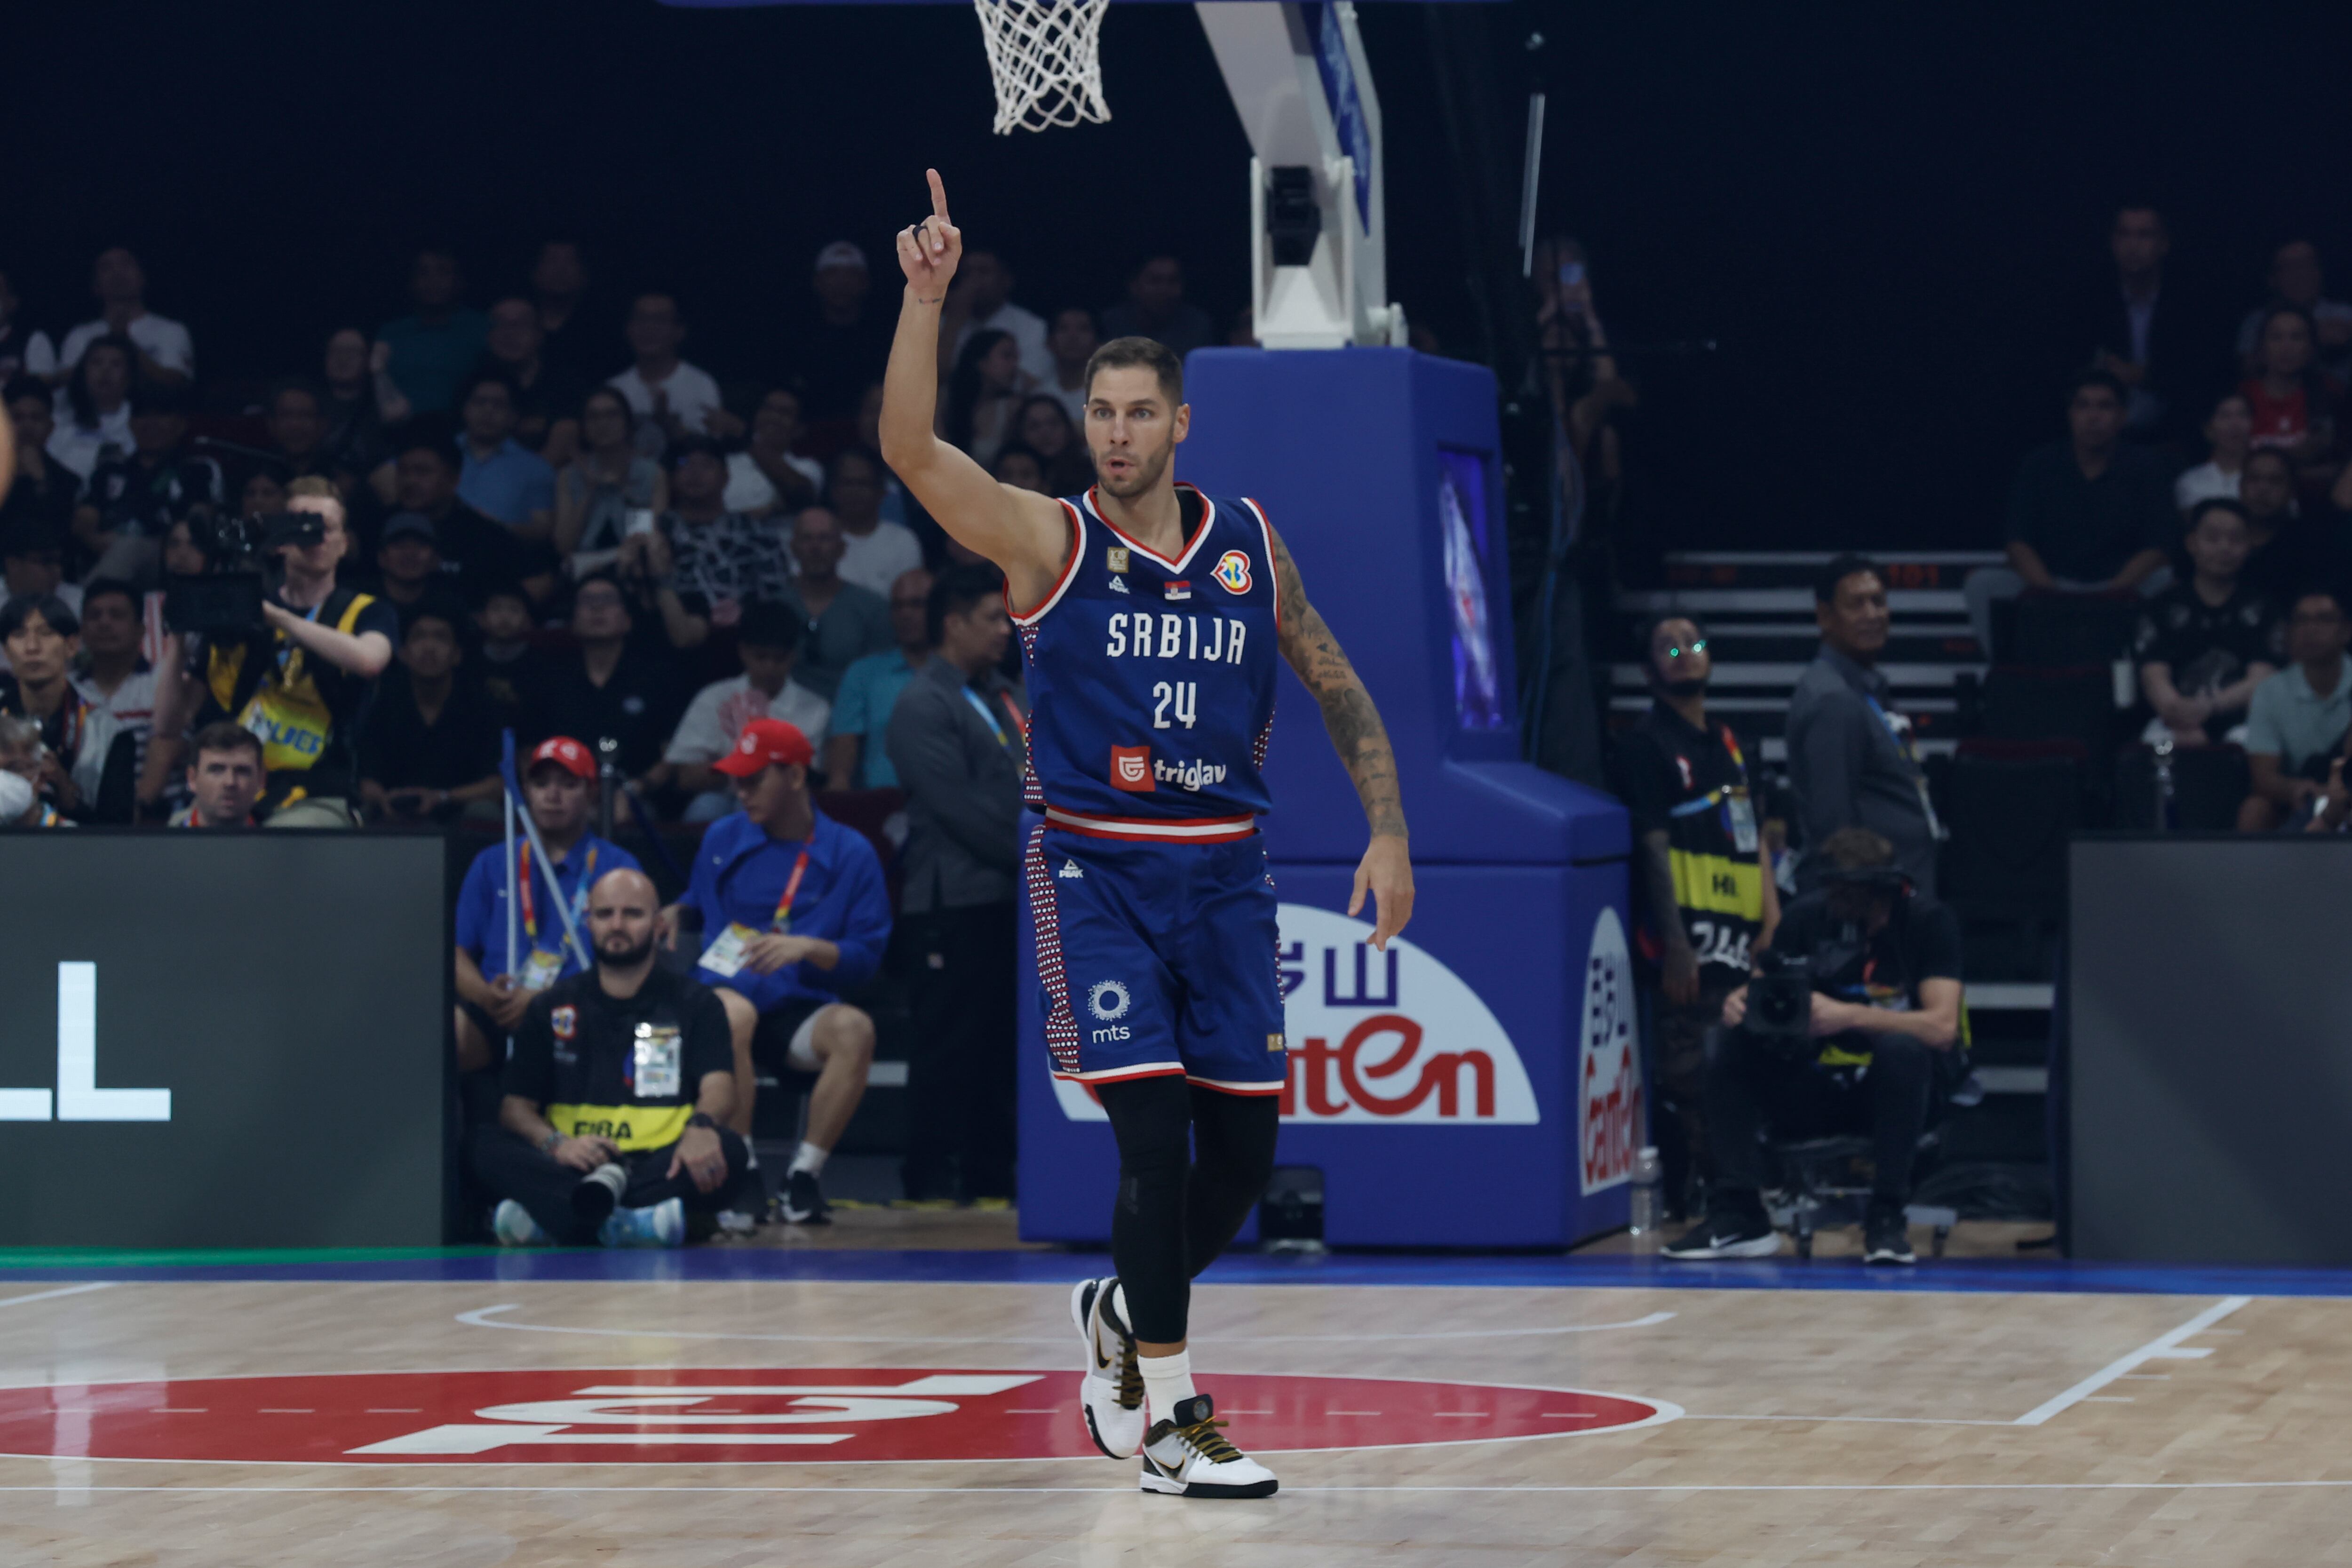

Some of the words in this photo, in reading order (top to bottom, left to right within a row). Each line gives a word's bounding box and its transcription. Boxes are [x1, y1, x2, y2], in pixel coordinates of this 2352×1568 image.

[1106, 613, 1247, 665] SRBIJA
[1153, 681, 1197, 729] 24
[1154, 758, 1226, 792] triglav
[0, 961, 171, 1122] L
[1092, 1025, 1131, 1044] mts
